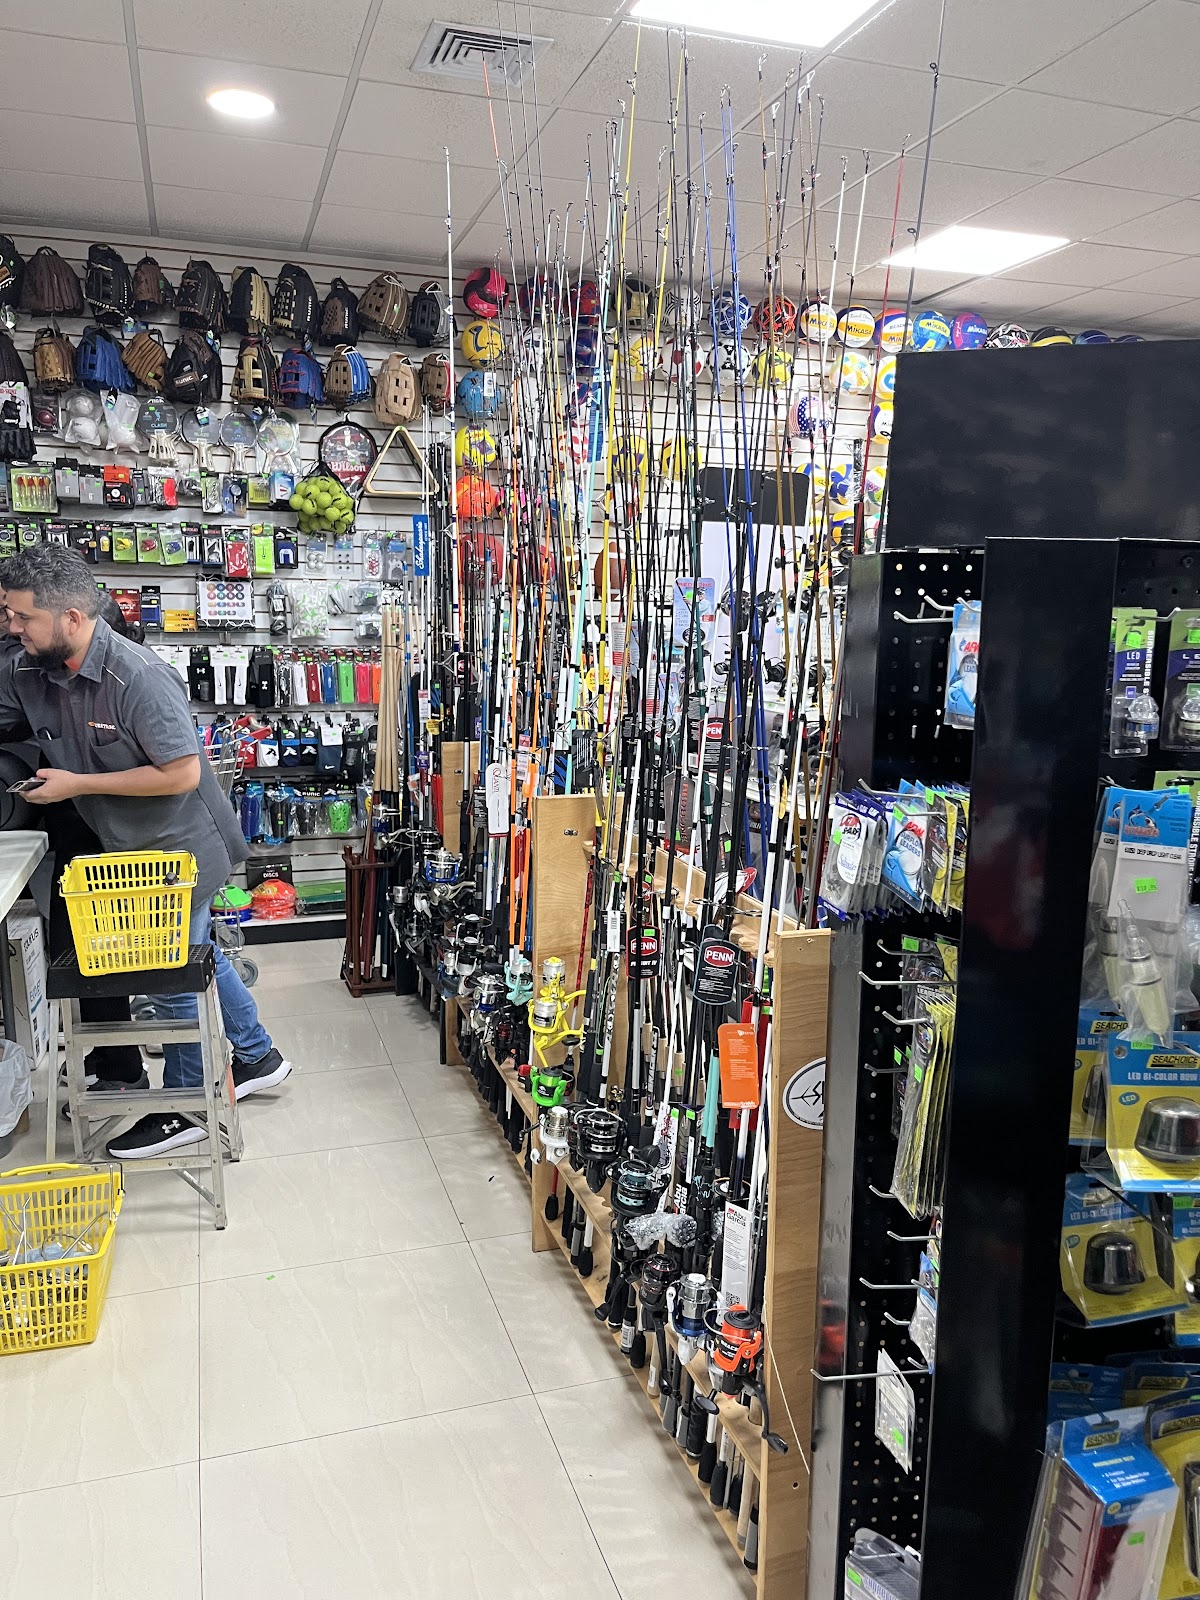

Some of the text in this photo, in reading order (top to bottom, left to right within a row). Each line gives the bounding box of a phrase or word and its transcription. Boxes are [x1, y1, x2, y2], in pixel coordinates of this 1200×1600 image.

[331, 461, 366, 472] Wilson
[1126, 651, 1141, 660] LED
[705, 950, 733, 963] PENN
[1152, 1055, 1198, 1064] SEACHOICE
[1127, 1072, 1141, 1080] LED
[1143, 1072, 1178, 1081] BI-COLOR
[1121, 1094, 1136, 1102] LED
